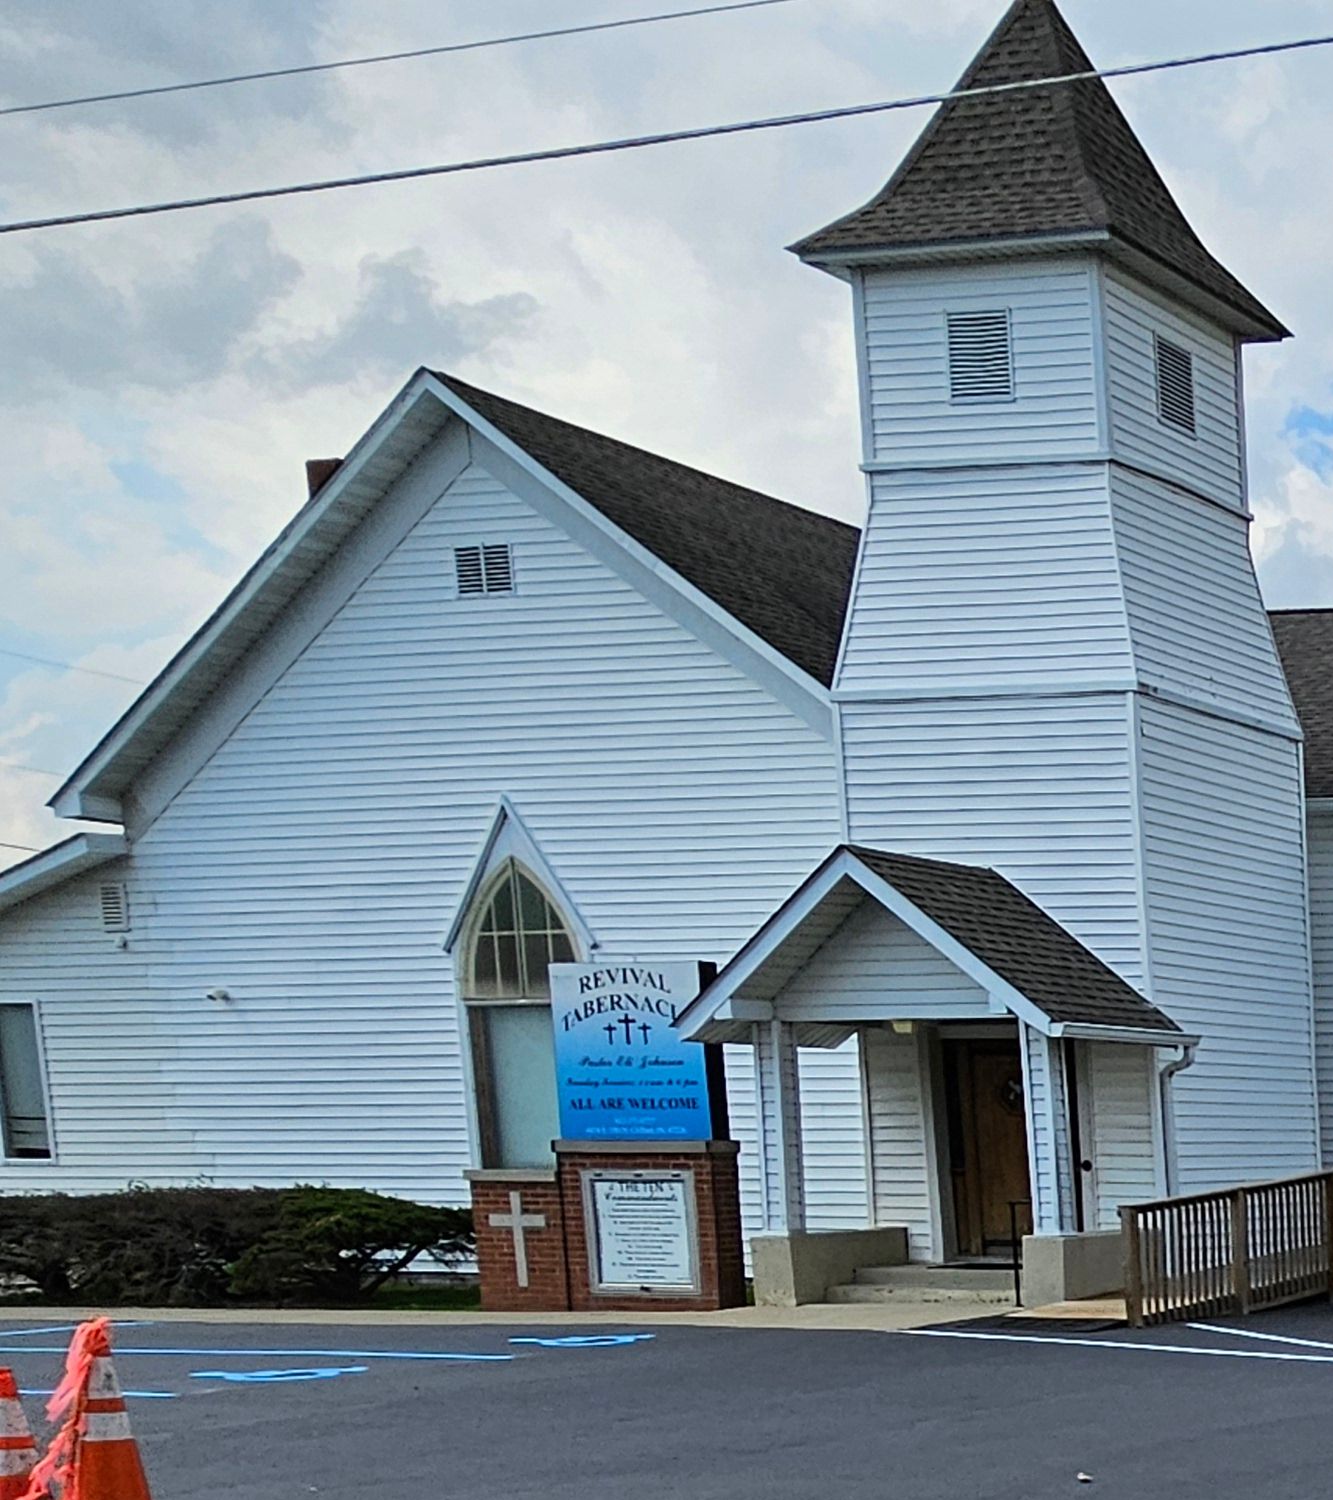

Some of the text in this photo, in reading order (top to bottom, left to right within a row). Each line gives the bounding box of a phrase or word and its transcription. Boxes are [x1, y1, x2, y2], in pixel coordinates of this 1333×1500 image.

[578, 967, 671, 994] REVIVAL
[561, 993, 678, 1032] TABERNACL
[569, 1097, 700, 1110] ALL ARE WELCOME
